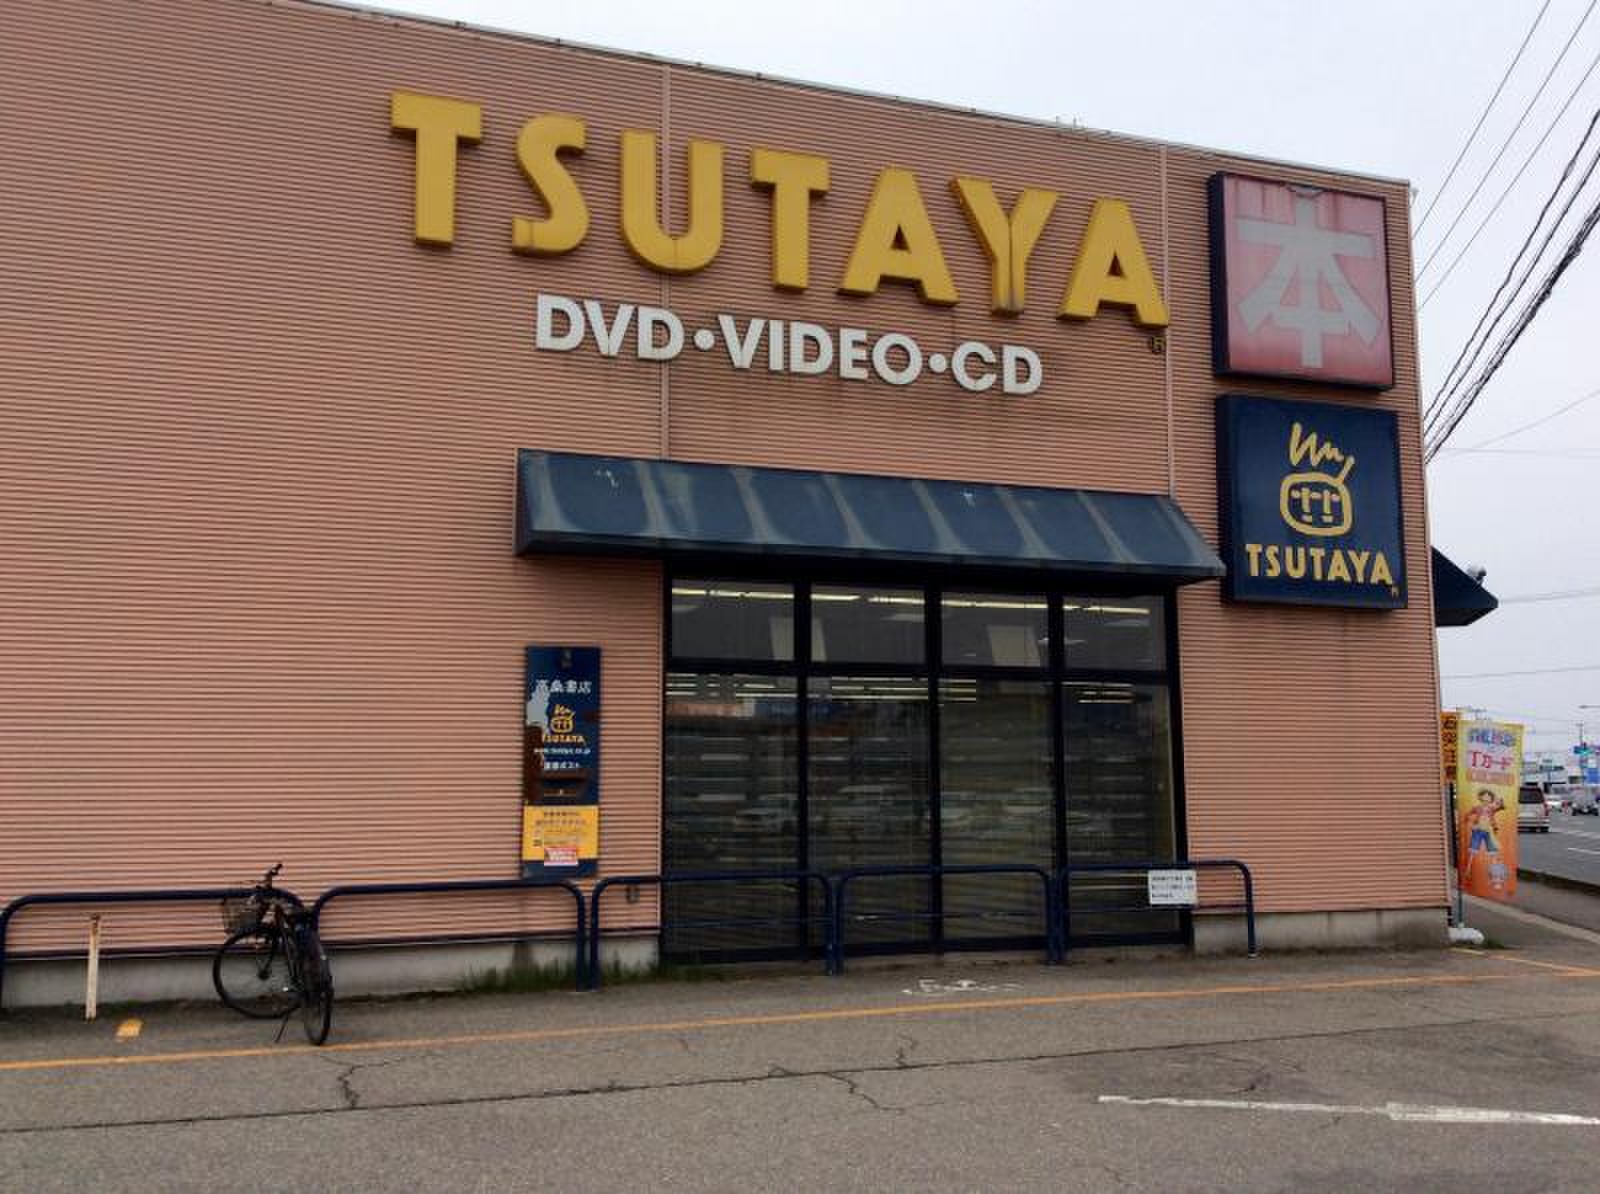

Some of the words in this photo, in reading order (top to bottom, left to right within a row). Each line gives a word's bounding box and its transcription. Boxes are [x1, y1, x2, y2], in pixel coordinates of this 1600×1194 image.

[390, 91, 1169, 328] TSUTAYA
[1236, 189, 1385, 369] 本
[1245, 543, 1393, 585] TSUTAYA
